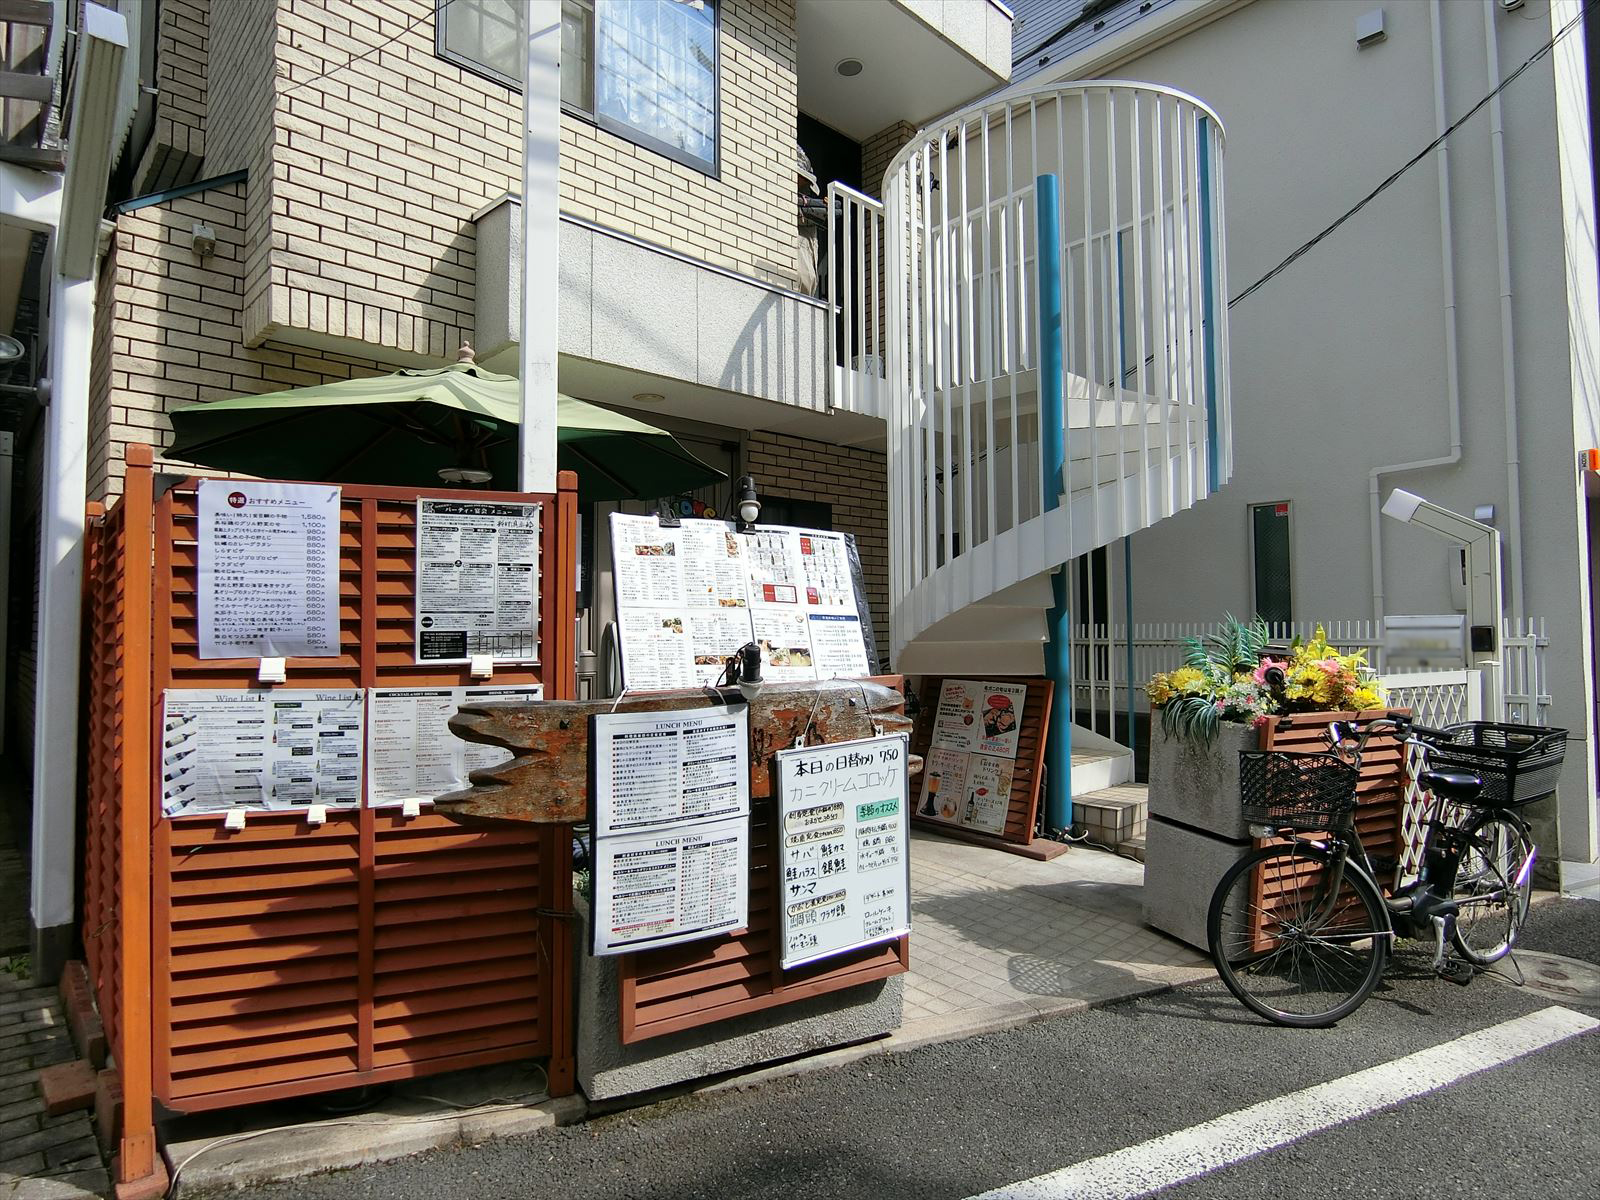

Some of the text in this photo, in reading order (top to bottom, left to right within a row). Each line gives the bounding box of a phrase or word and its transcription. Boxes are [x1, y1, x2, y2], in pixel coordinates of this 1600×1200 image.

[248, 498, 306, 506] おすすめメニュー
[490, 507, 514, 515] メニュー
[215, 694, 256, 702] Wine List
[315, 693, 337, 701] Wine
[682, 720, 703, 728] MENU
[793, 748, 899, 777] 本日の日替わり 750
[789, 765, 899, 803] カニクリームコロッケ
[859, 802, 898, 818] 季節のオススメ
[655, 839, 680, 847] LUNCH
[790, 846, 815, 861] サバ
[820, 844, 846, 857] 鮭カマ
[821, 858, 847, 875] 銀鮭
[786, 867, 817, 883] 鮭ハラス
[789, 882, 818, 897] サンマ
